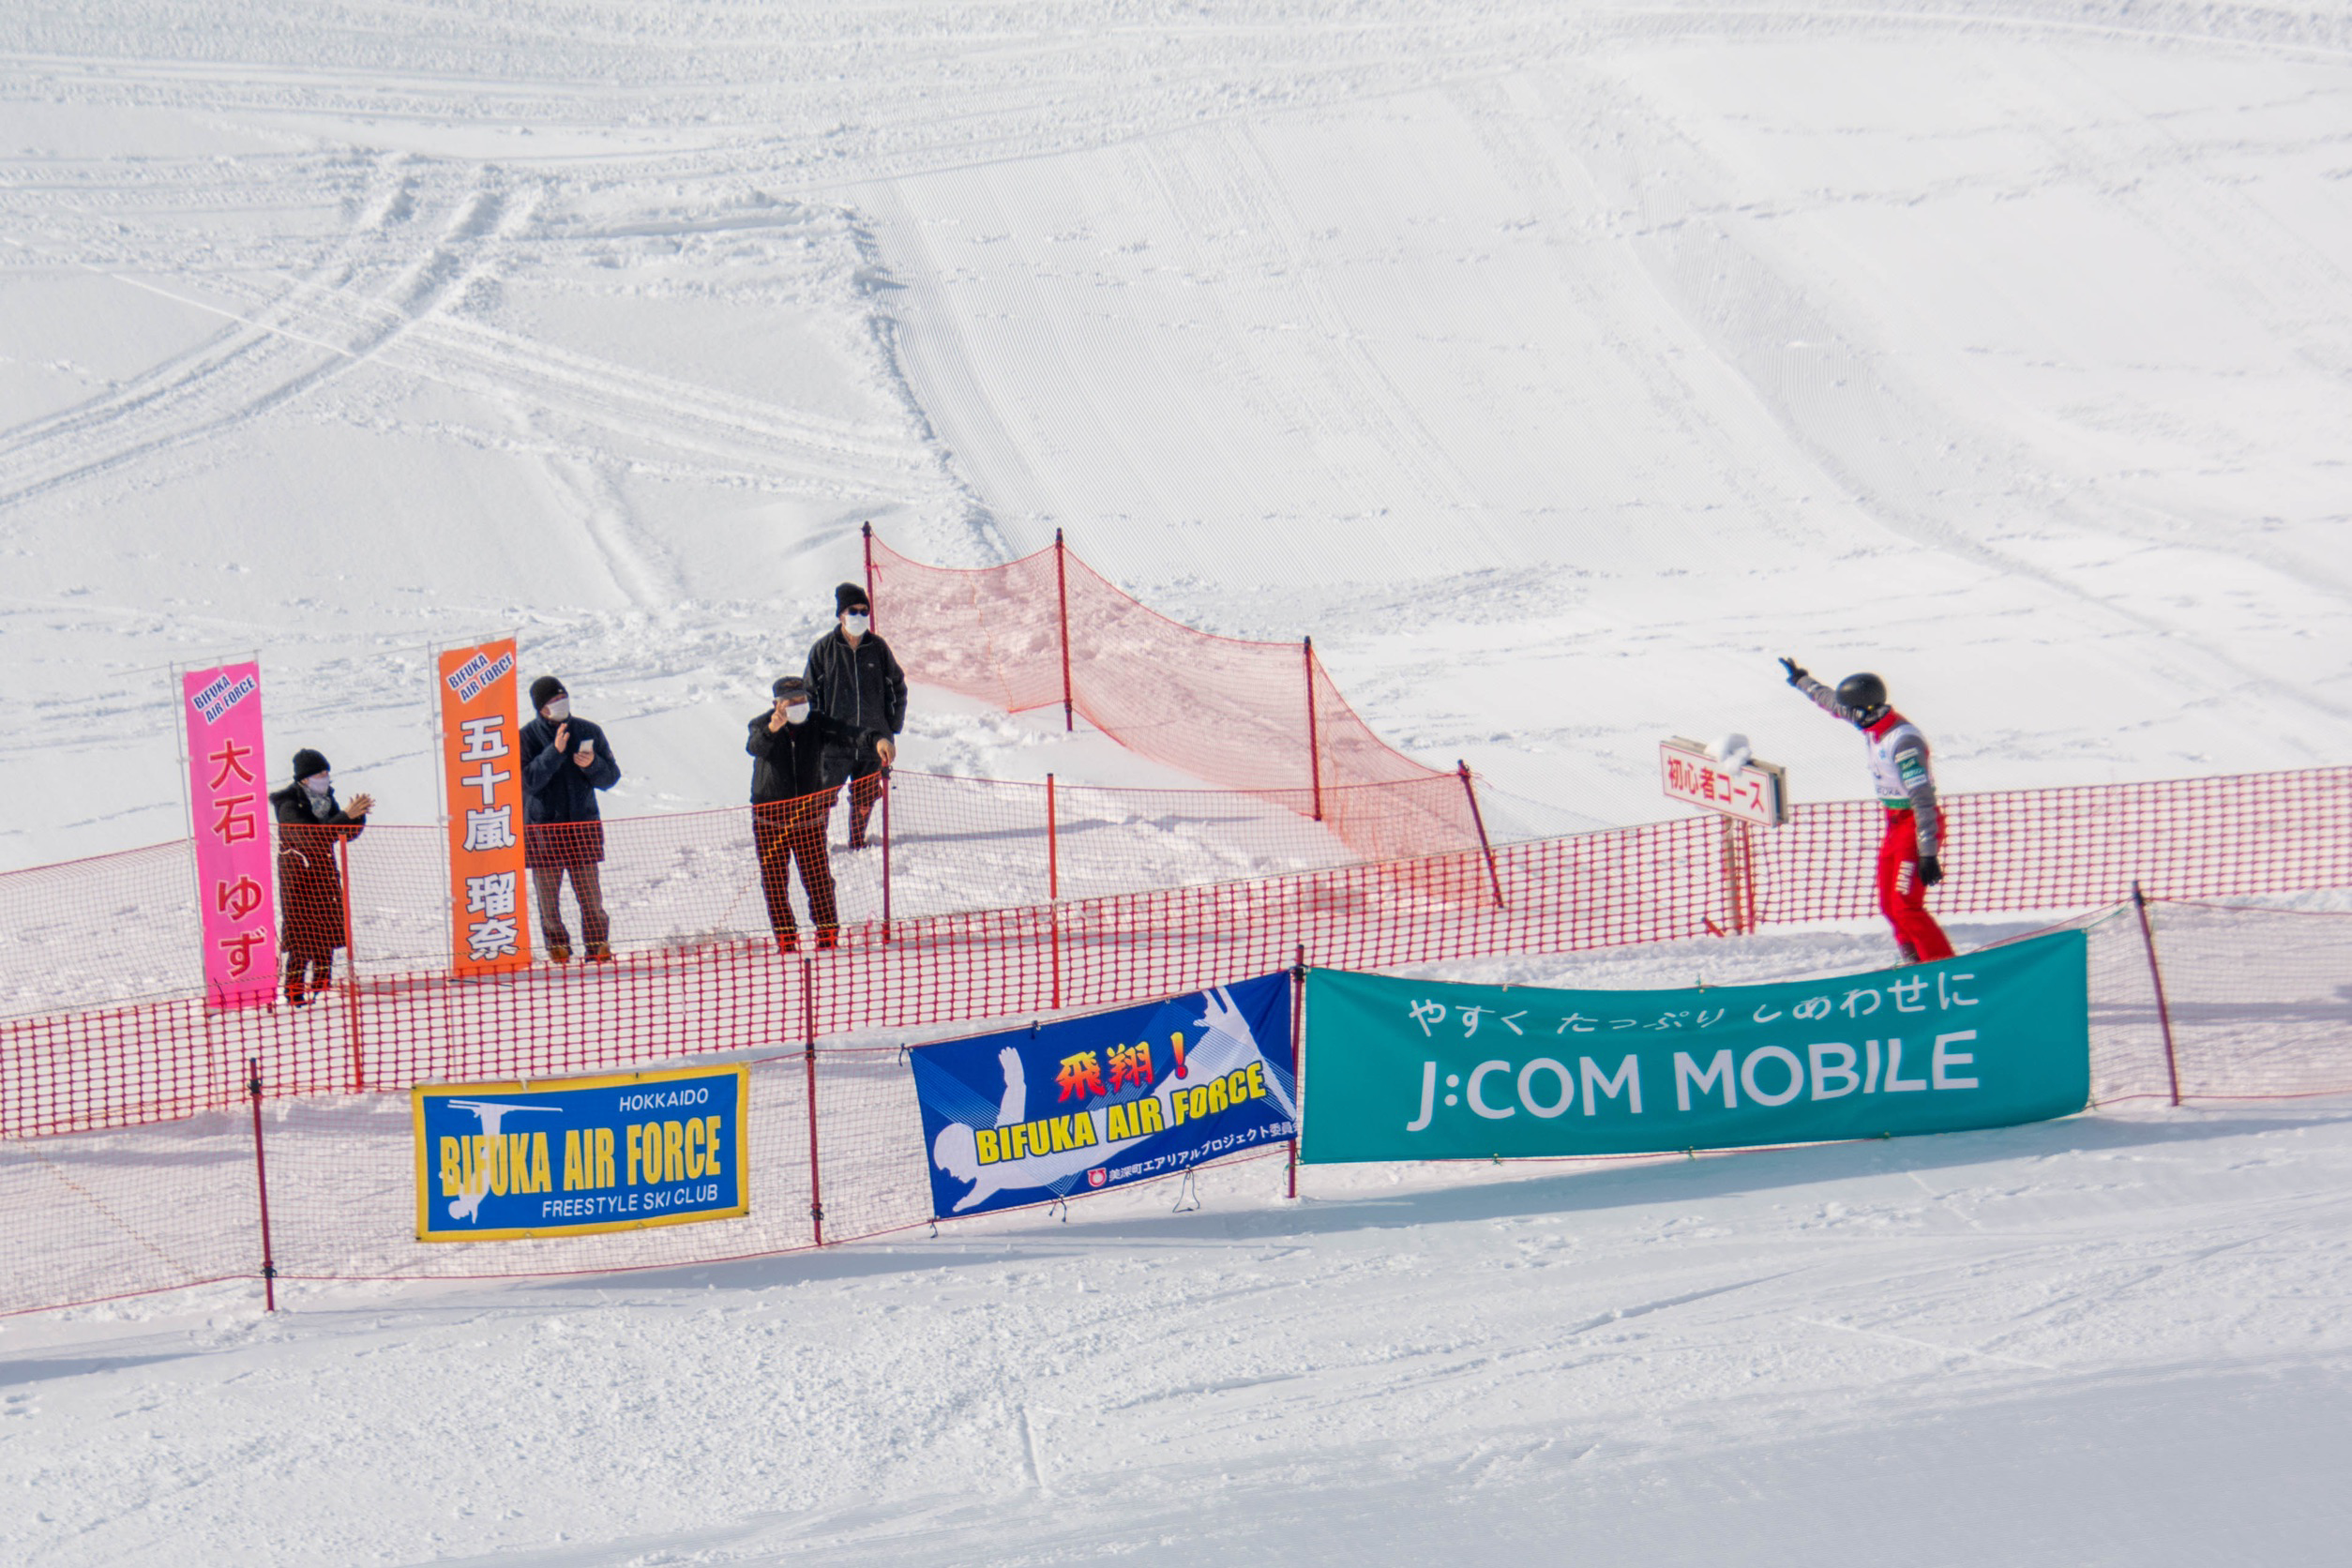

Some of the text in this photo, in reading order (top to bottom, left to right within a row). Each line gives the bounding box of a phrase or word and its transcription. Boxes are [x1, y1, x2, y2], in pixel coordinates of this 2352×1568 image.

[193, 675, 231, 710] BIFUKA
[448, 655, 488, 688] BIFUKA
[460, 680, 480, 701] AIR
[205, 676, 256, 723] AIR FORCE
[1667, 756, 1765, 813] 初心者コース
[208, 738, 266, 978] 大石 ゆず
[460, 715, 518, 961] 五十嵐 瑠奈
[1895, 860, 1916, 896] JAPAN
[1409, 999, 1528, 1037] やすく
[619, 1088, 709, 1112] HOKKAIDO
[1406, 1029, 1980, 1132] J:COM MOBILE
[974, 1061, 1268, 1165] BIFUKA AIR FORCE
[440, 1115, 721, 1197] BIFUKA AIR FORCE
[542, 1184, 718, 1218] FREESTYLE SKI CLUB
